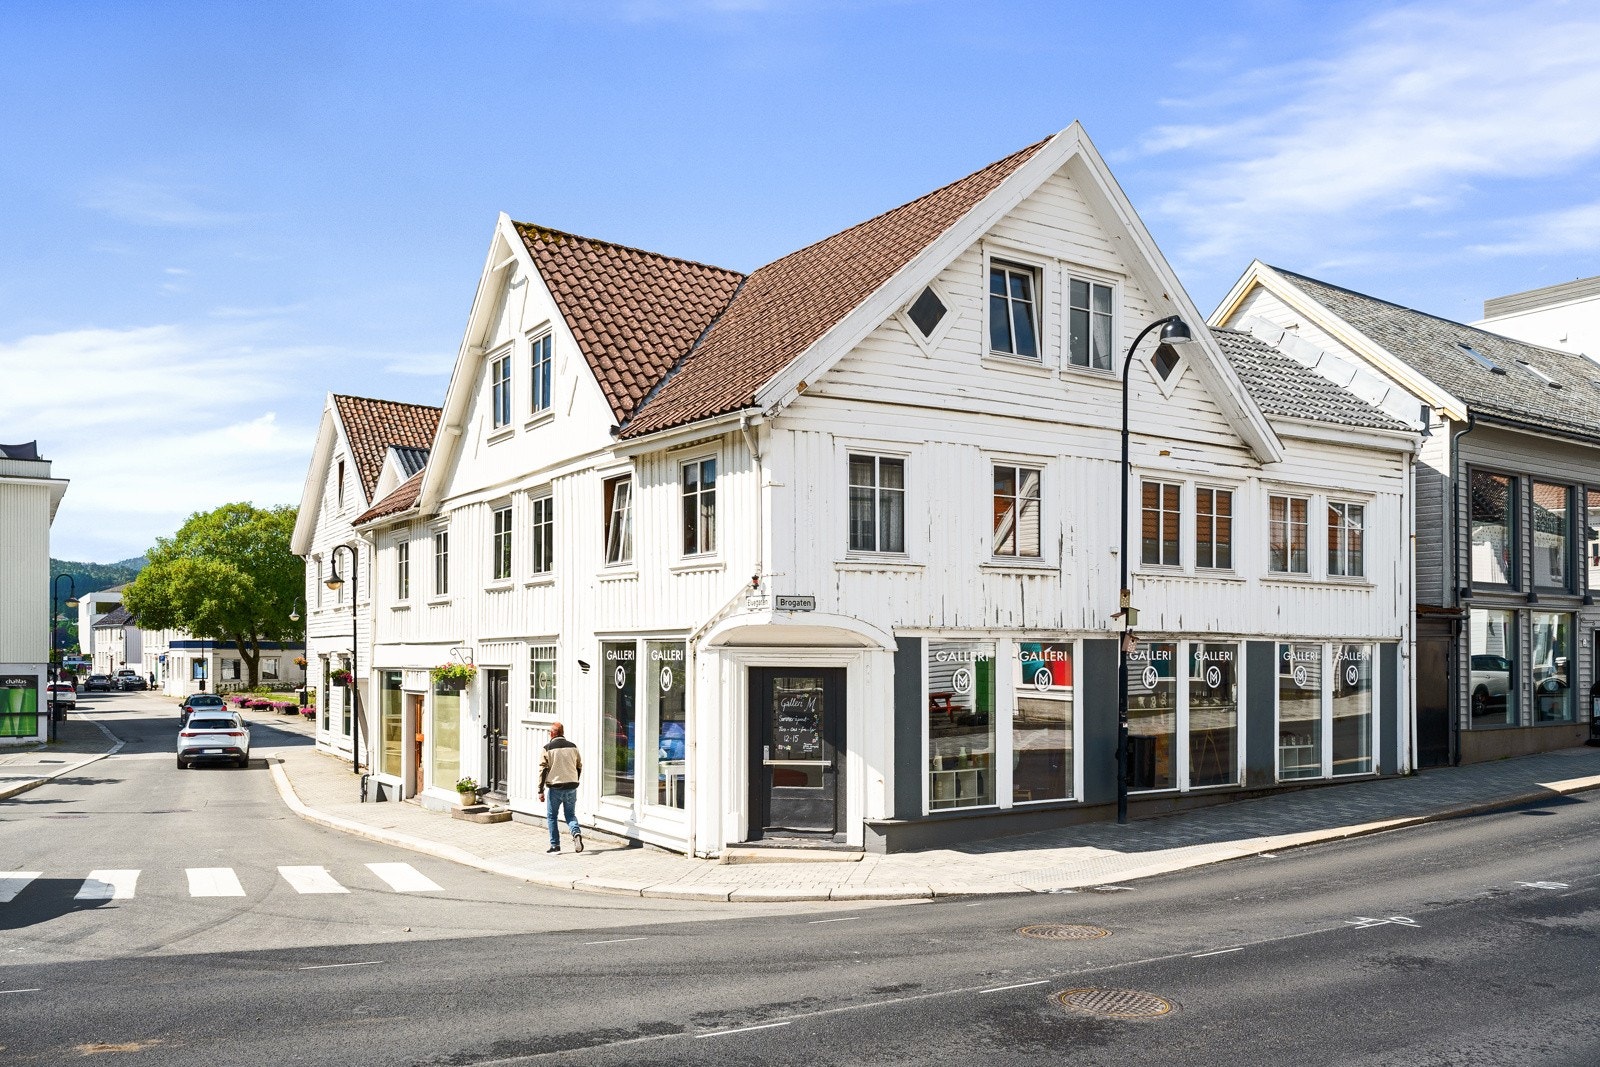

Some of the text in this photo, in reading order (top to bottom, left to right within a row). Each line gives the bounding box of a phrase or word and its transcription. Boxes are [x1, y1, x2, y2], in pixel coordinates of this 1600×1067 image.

[780, 599, 812, 608] Brogaten
[606, 650, 635, 660] GALLERI
[651, 650, 684, 661] GALLERI
[935, 651, 989, 662] GALLERI
[1019, 651, 1067, 662] GALLERI
[1129, 650, 1172, 661] GALLERI
[1194, 651, 1233, 661] GALLERI
[1283, 651, 1318, 661] GALLERI
[804, 697, 817, 713] M
